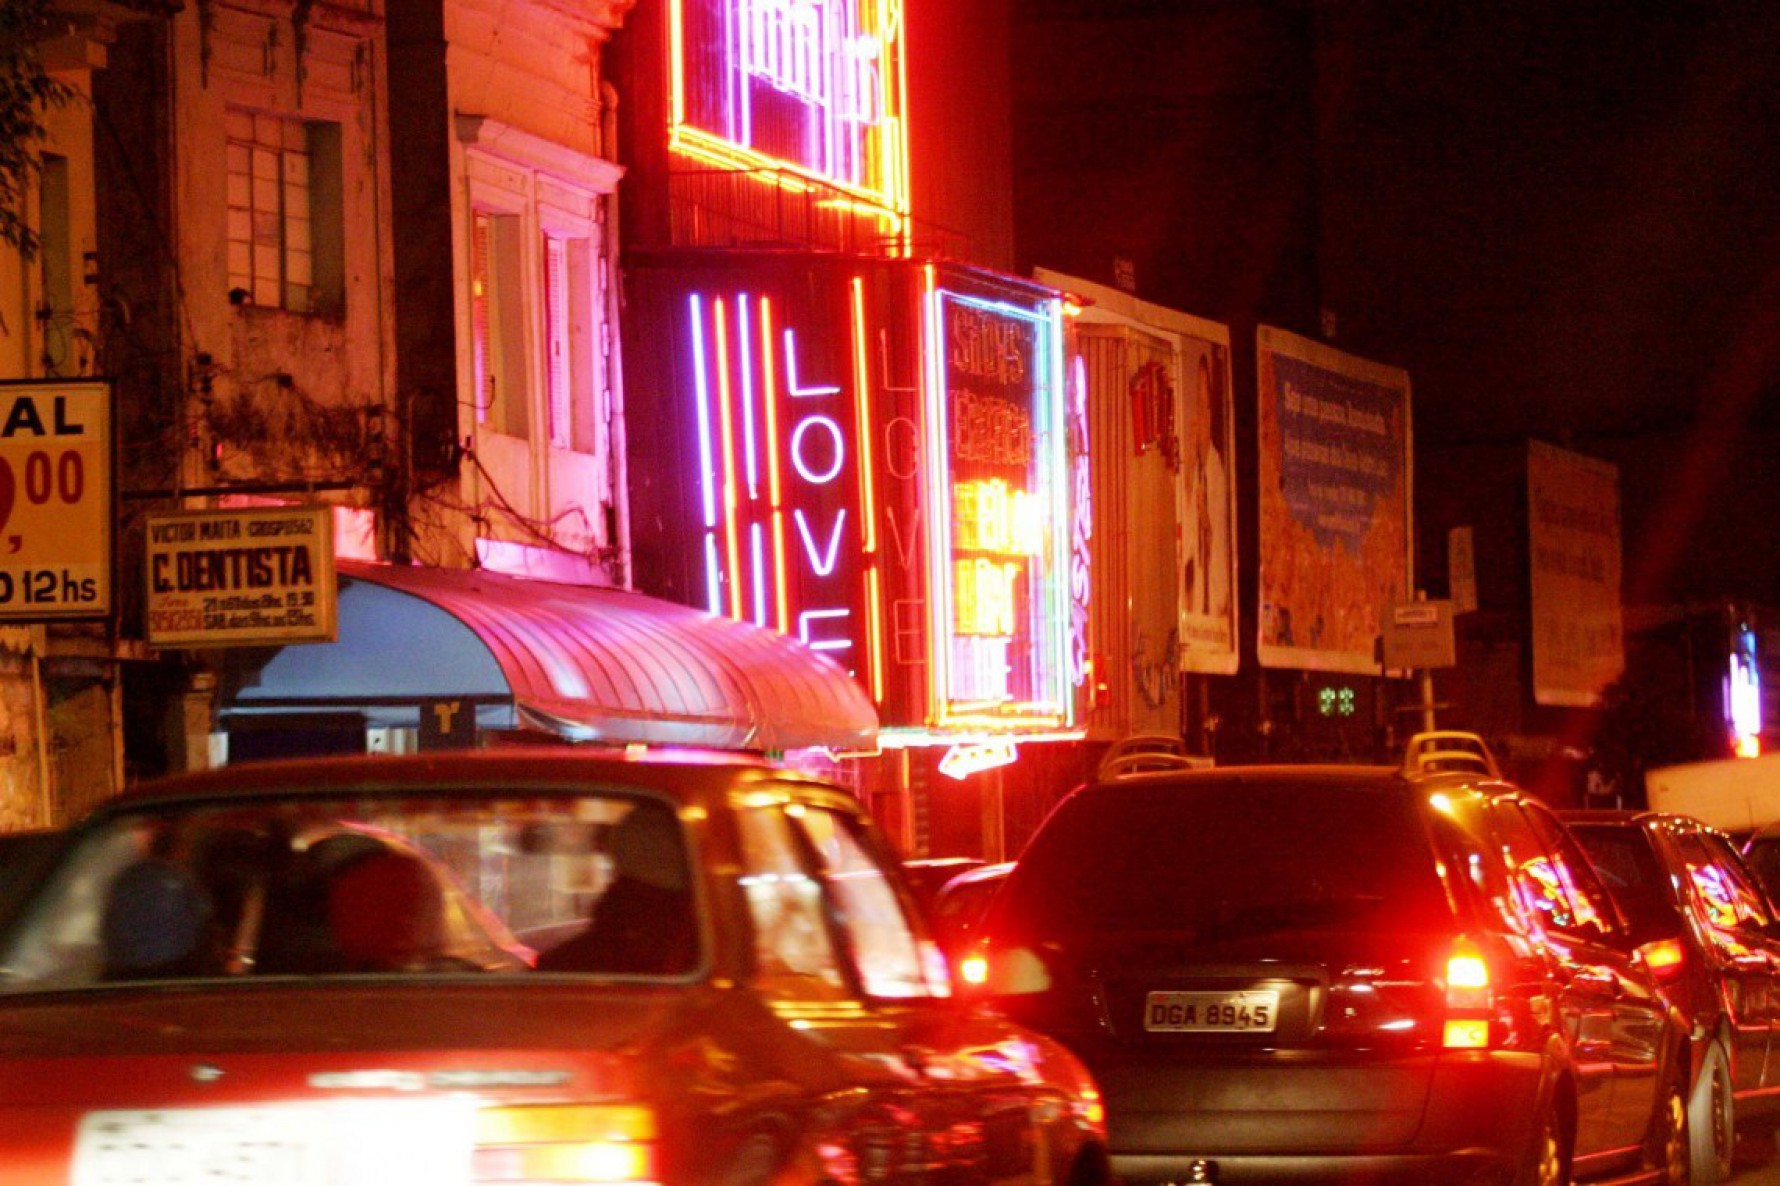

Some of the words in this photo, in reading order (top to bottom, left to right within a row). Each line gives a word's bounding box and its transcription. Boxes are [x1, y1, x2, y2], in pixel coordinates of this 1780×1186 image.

[2, 396, 85, 438] AL
[784, 328, 853, 651] LOVE
[880, 328, 927, 664] LOVE
[1152, 1004, 1198, 1025] DGA
[1206, 1005, 1269, 1026] 8945
